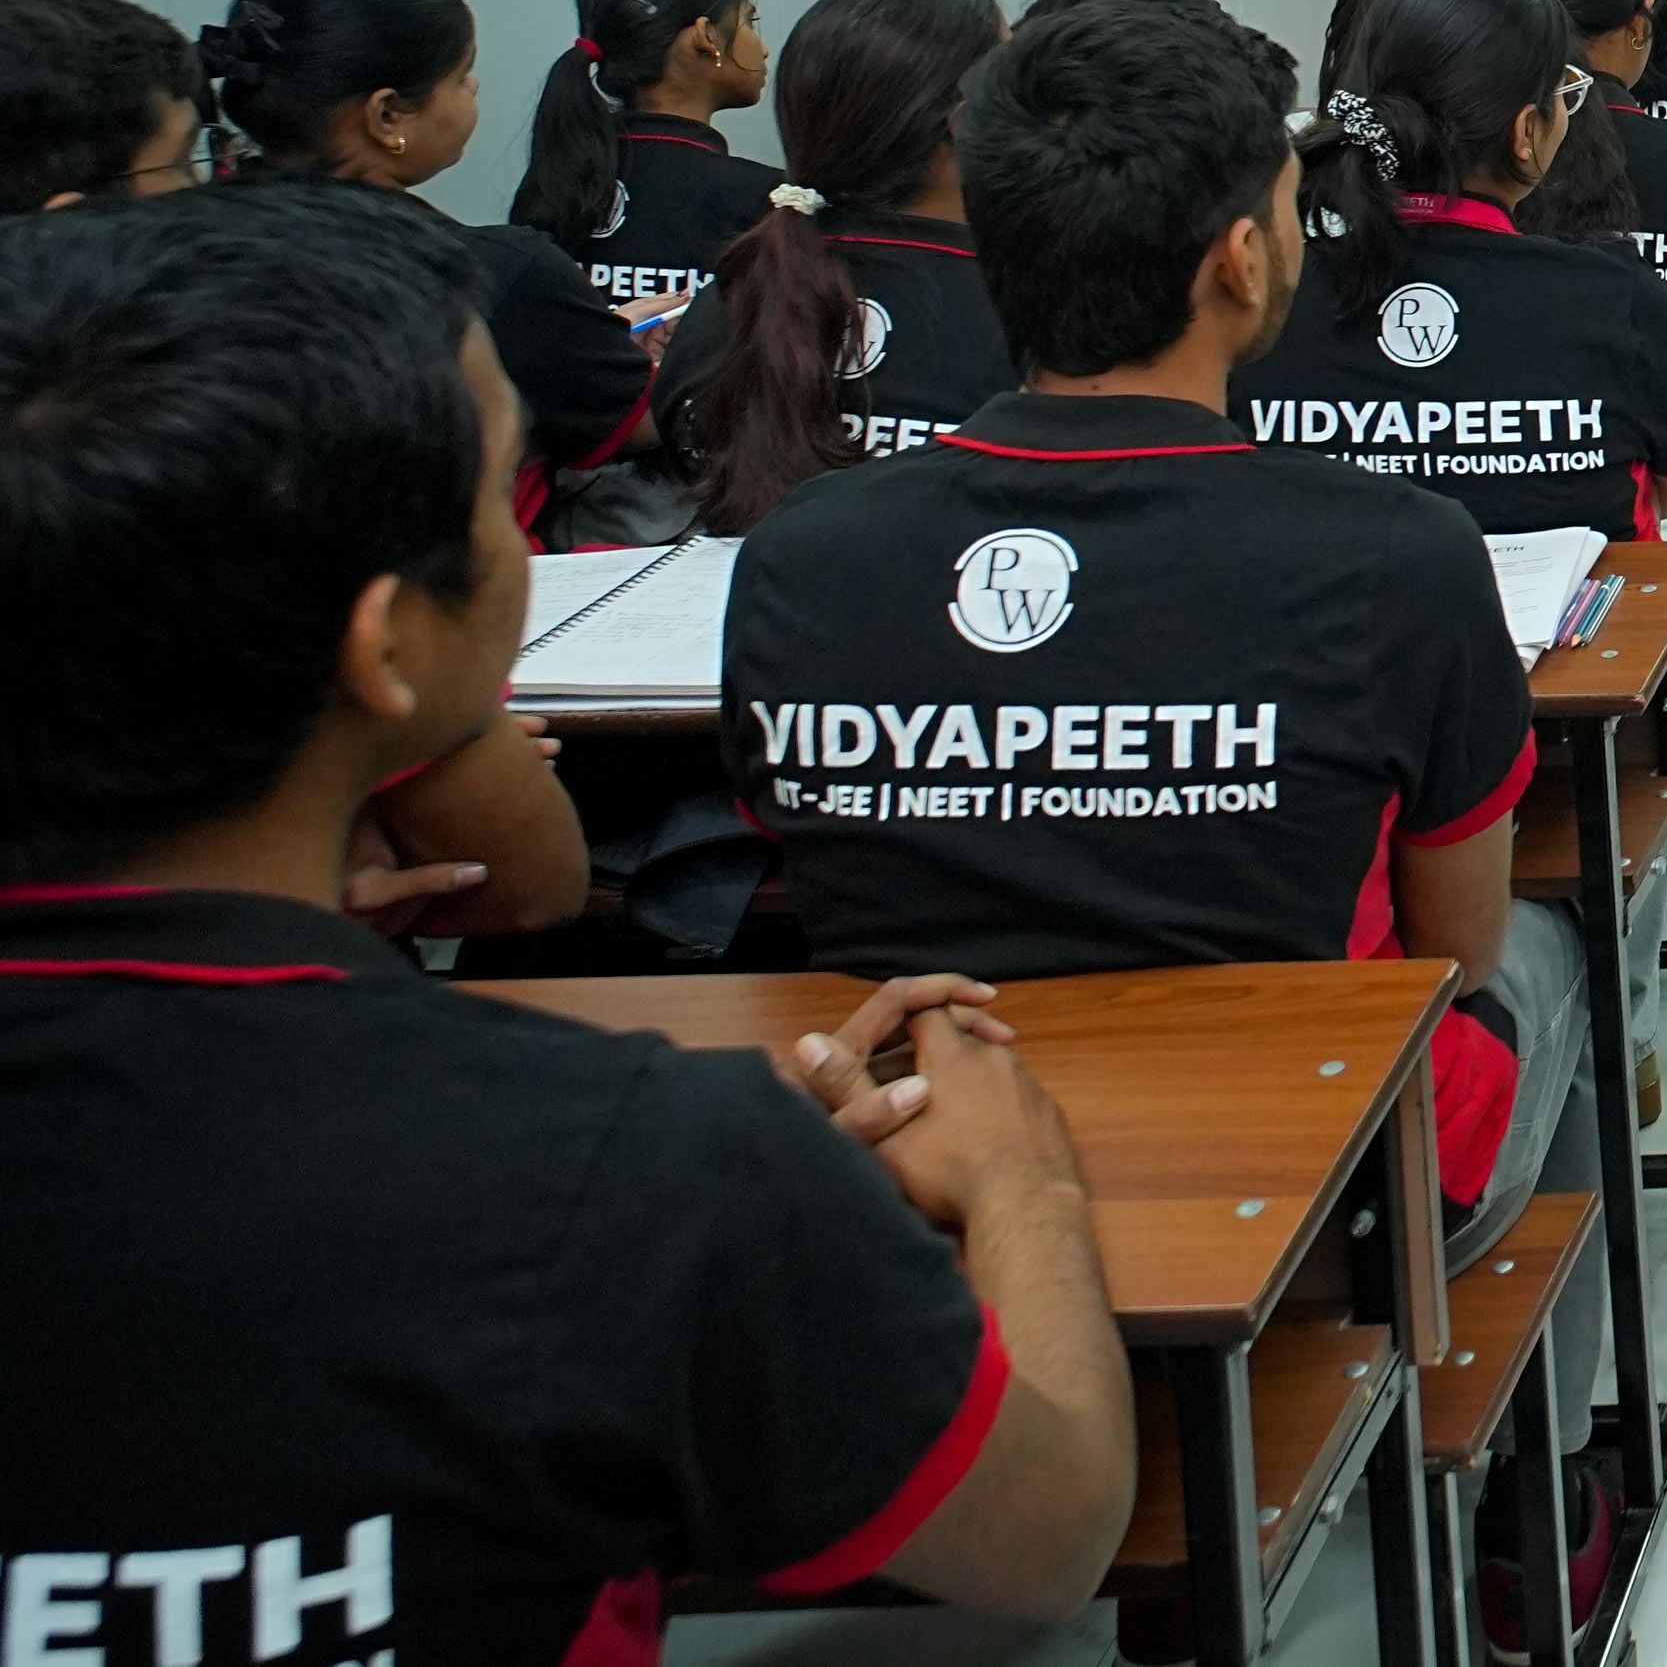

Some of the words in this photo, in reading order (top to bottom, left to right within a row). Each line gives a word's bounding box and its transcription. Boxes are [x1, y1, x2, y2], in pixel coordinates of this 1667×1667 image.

[588, 263, 716, 299] PEETH
[1397, 297, 1449, 358] PW
[1250, 398, 1603, 445] VIDYAPEETH
[1356, 453, 1417, 475] NEET
[1436, 449, 1606, 475] FOUNDATION
[981, 547, 1059, 635] PW
[750, 700, 1278, 771] VIDYAPEETH
[774, 777, 872, 818] IIT-JEE
[898, 785, 995, 818] NEET
[1021, 781, 1278, 819] FOUNDATION
[5, 1512, 395, 1667] ETH
